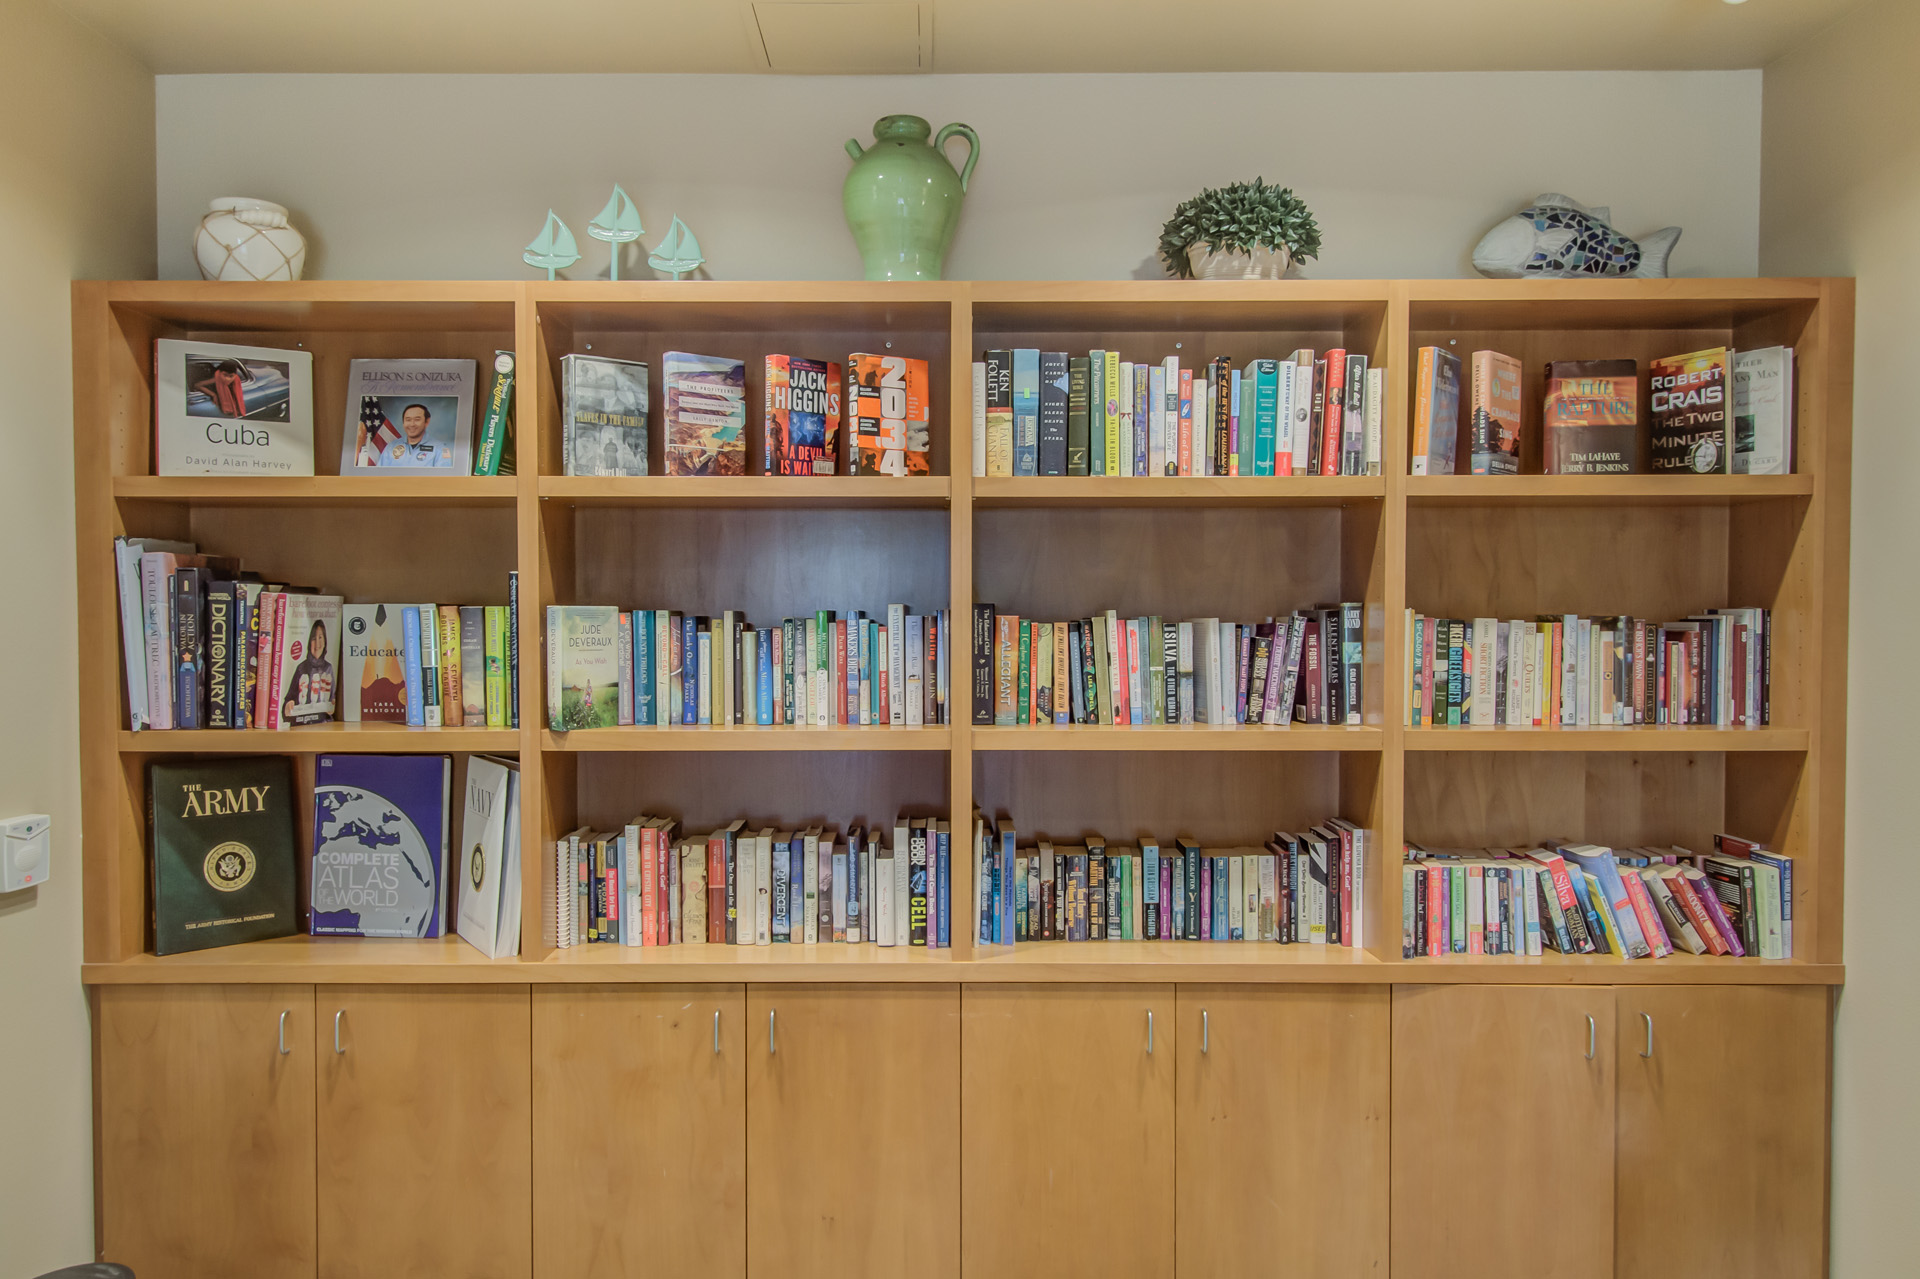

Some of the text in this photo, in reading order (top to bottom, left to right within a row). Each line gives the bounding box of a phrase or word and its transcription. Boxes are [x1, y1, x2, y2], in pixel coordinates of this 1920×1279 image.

[362, 372, 402, 382] ELLISON
[415, 373, 462, 382] ONIZUKA
[789, 370, 826, 390] JACK
[988, 360, 1009, 402] KEN FOLLETT
[1651, 368, 1722, 390] ROBERT
[493, 374, 506, 414] SCRABBLE
[1579, 383, 1612, 396] THE
[1652, 386, 1722, 412] CRAIS
[775, 387, 839, 416] HIGGINS
[1557, 401, 1635, 416] RAPTURE
[488, 415, 499, 437] Players
[1652, 411, 1723, 429] THE TWO
[206, 423, 269, 446] Cuba
[988, 425, 1009, 464] FALL OF GIANTS
[1182, 440, 1188, 448] of
[1652, 430, 1723, 449] MINUTE
[186, 456, 217, 465] David
[223, 459, 247, 467] Alan
[253, 460, 292, 470] Harvey
[482, 439, 495, 472] Dictionary
[789, 446, 795, 459] A
[1182, 450, 1188, 459] Pi
[1652, 456, 1693, 469] RULE
[781, 460, 790, 474] IS
[180, 614, 187, 625] IN
[275, 599, 284, 651] barefoot contessa
[448, 619, 456, 641] JAMES
[581, 625, 601, 634] JUDE
[187, 614, 195, 650] ACTION
[569, 637, 612, 647] DEVERAUX
[350, 645, 405, 656] Educate
[928, 627, 936, 660] Waiting
[1165, 633, 1176, 662] SILVA
[1309, 634, 1317, 670] THE FOSSIL
[1331, 617, 1339, 684] SILENT TEARS
[1449, 628, 1463, 680] KERR GREEKS
[211, 604, 226, 706] DICTIONARY
[848, 658, 857, 674] DIET
[272, 666, 280, 677] easy
[450, 664, 458, 701] SEVENTH
[929, 673, 935, 684] HA
[1001, 640, 1011, 705] ALLEGIANT
[1524, 664, 1534, 693] QUILTS
[1448, 683, 1461, 702] GIFTS
[183, 784, 202, 792] THE
[181, 786, 271, 818] ARMY
[319, 853, 399, 866] COMPLETE
[911, 837, 919, 865] COOK
[318, 866, 399, 888] ATLAS
[1090, 861, 1098, 886] MARTINI
[1147, 864, 1155, 900] JOHN GRISHAM
[319, 889, 399, 906] THE WORLD
[776, 869, 785, 926] DIVERGENT
[1554, 874, 1571, 905] Silva
[911, 897, 926, 930] CELL
[1068, 903, 1076, 927] Remorse
[1687, 893, 1708, 923] KOONTZ
[197, 921, 212, 929] ARMY
[1147, 909, 1155, 936] LITIGATORS
